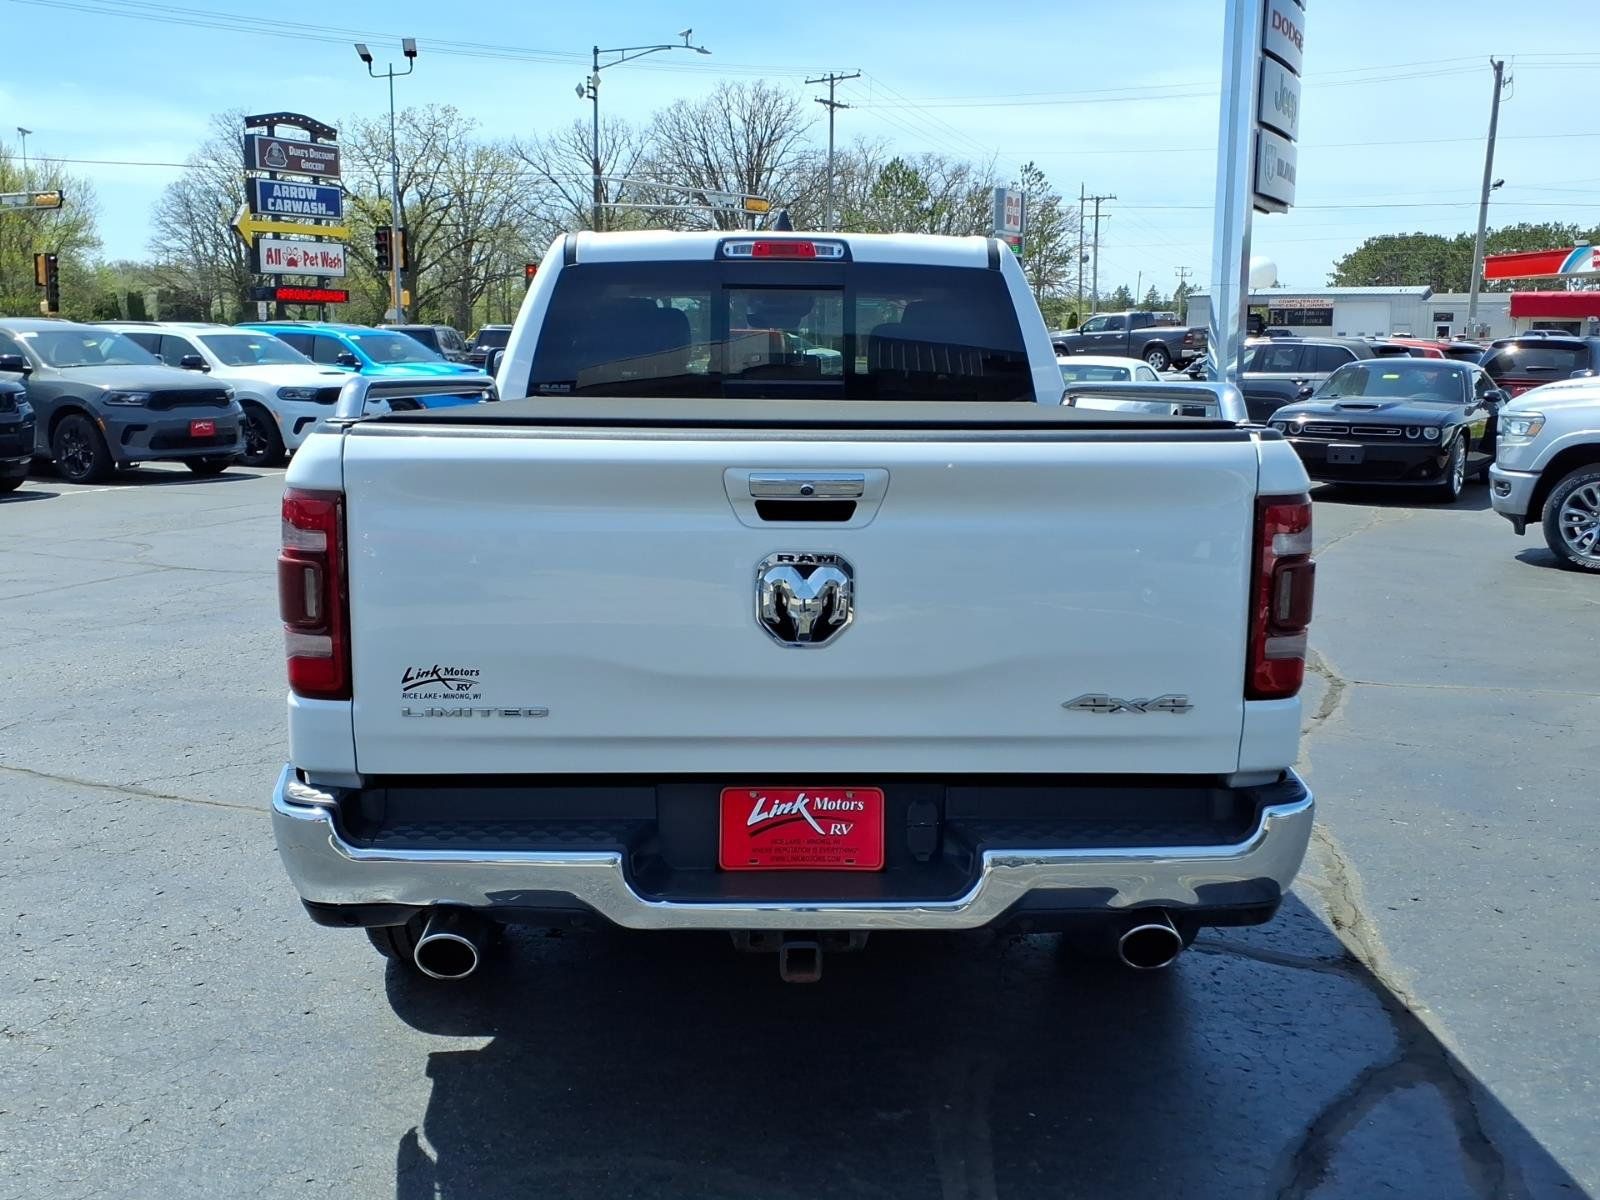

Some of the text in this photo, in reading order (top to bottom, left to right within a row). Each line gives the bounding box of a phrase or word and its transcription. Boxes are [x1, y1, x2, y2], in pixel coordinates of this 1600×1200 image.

[1275, 72, 1297, 128] Jeep
[273, 184, 317, 200] ARROW
[267, 198, 326, 215] CARWASH
[266, 248, 342, 269] All Pet Wash
[777, 554, 837, 562] RAM
[401, 664, 480, 688] Link Motors
[456, 683, 473, 691] RV
[402, 692, 419, 700] RICE
[419, 692, 438, 700] LAKE
[472, 692, 482, 700] WI
[401, 706, 550, 718] LIMITED
[747, 792, 864, 834] Link Motors
[830, 823, 854, 835] RV
